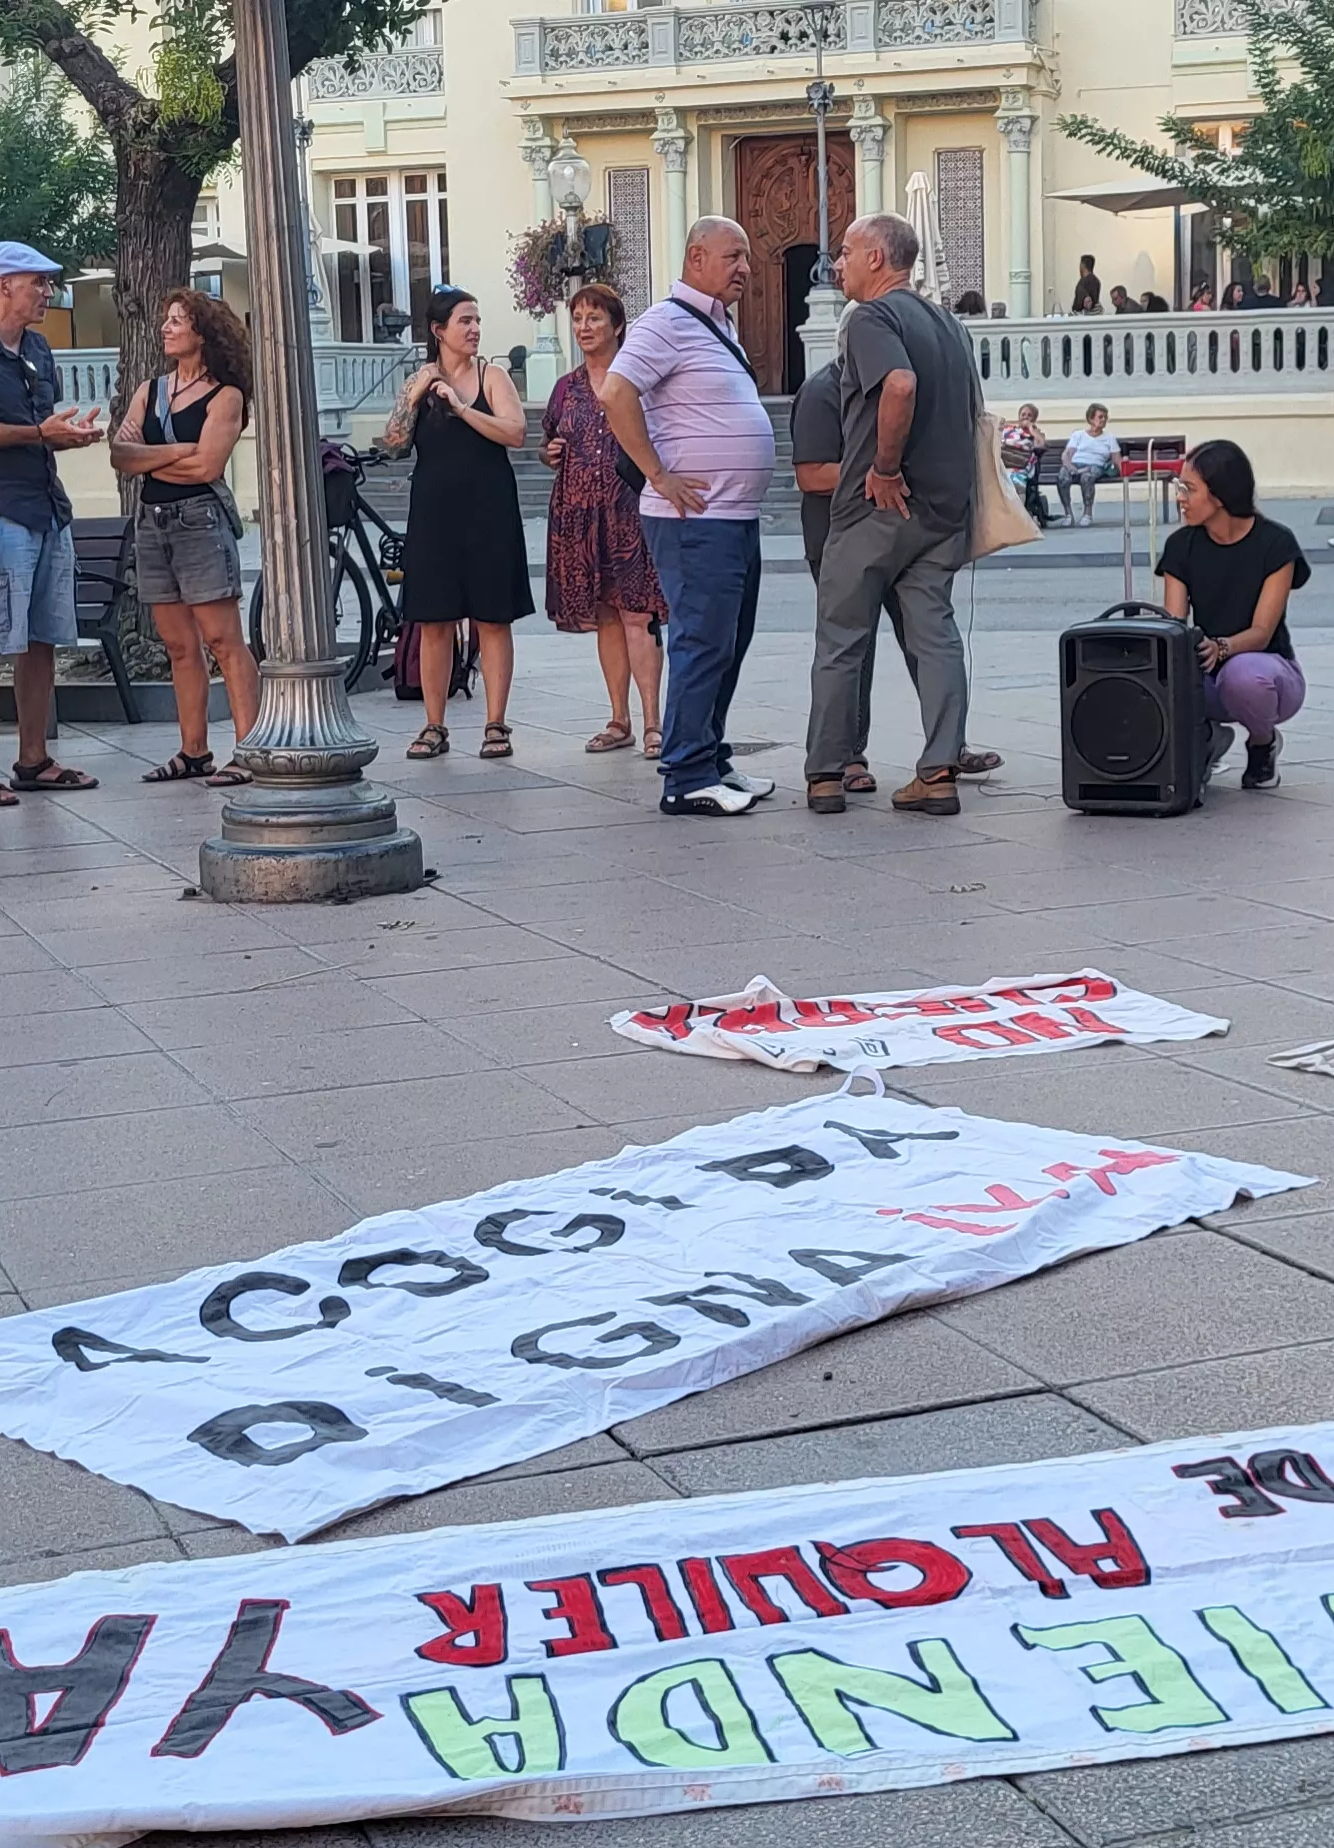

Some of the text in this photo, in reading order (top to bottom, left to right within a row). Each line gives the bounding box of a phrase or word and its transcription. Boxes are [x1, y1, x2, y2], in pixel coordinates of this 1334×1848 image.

[51, 1119, 959, 1373] ACOGIDA
[186, 1248, 923, 1467] DIGNA
[415, 1505, 1151, 1668] ALQUILER
